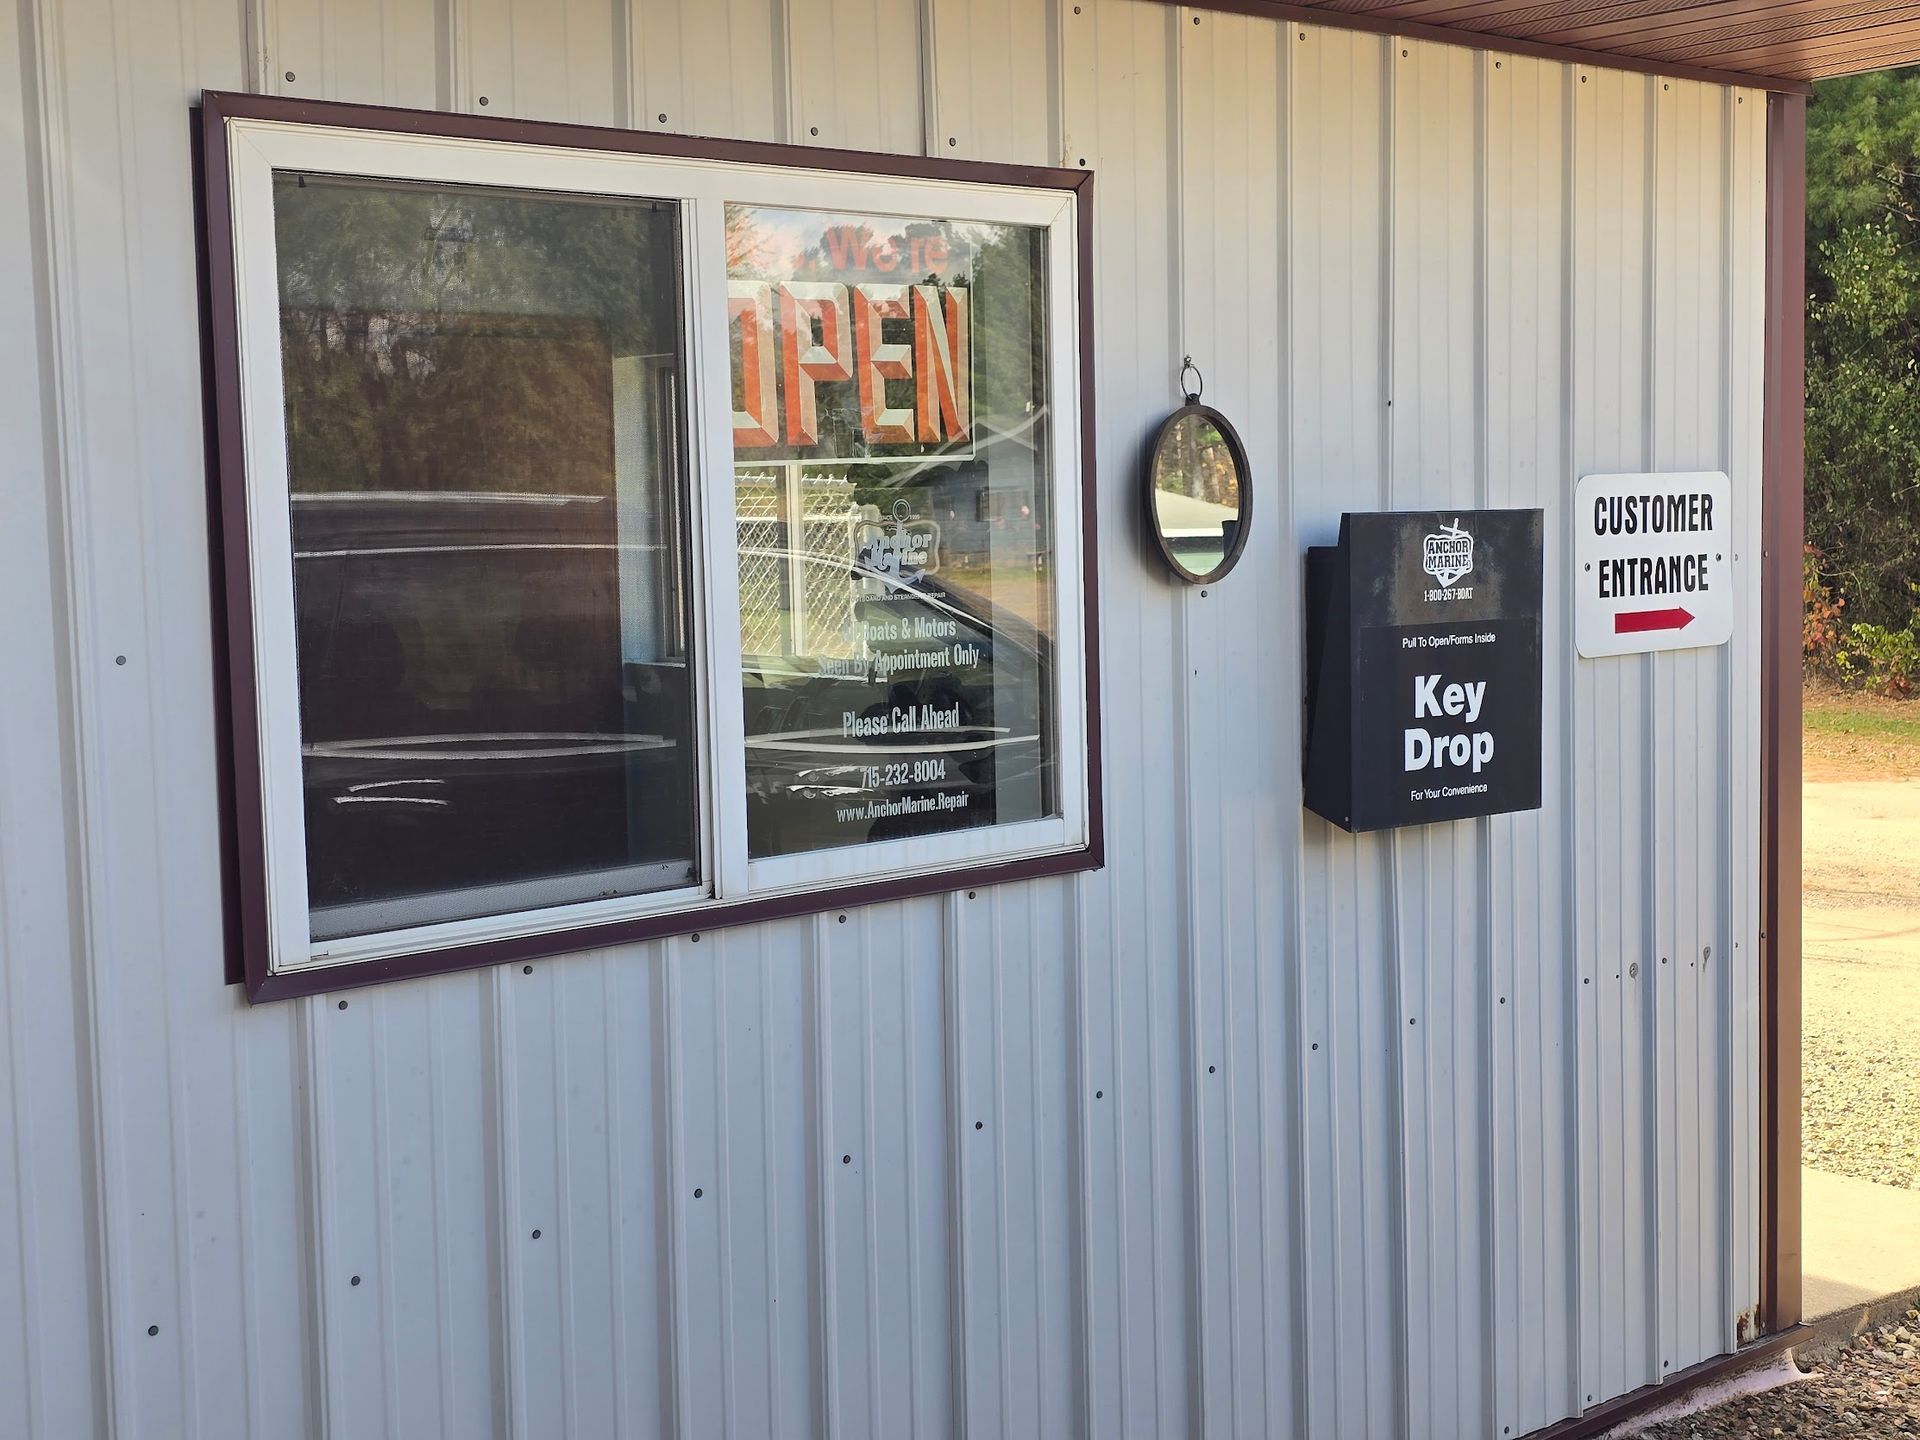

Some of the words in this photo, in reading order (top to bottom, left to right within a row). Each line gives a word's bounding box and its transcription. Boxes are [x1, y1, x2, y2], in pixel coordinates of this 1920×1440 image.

[825, 223, 949, 274] Were
[727, 280, 970, 447] OPEN
[1594, 493, 1713, 536] CUSTOMER
[1428, 541, 1469, 554] ANCHOR
[1428, 555, 1468, 569] MARINE
[1599, 553, 1709, 598] ENTRANCE
[863, 620, 898, 641] Boats
[901, 617, 911, 638] &
[914, 617, 957, 638] Motors
[1402, 637, 1417, 649] Pull
[1418, 636, 1427, 647] To
[1428, 633, 1473, 649] Open/Forms
[1474, 631, 1496, 644] Inside
[818, 655, 849, 675] Seen
[854, 653, 870, 678] By
[875, 648, 950, 675] Appointment
[953, 643, 979, 668] Only
[1415, 674, 1487, 723] Key
[843, 711, 888, 738] Please
[891, 705, 916, 733] Call
[921, 702, 960, 730] Ahead
[1404, 727, 1494, 773] Drop
[860, 759, 946, 789] 715-232-8004
[837, 791, 970, 823] www.AnchorMarine.Repair
[1411, 790, 1424, 801] For
[1424, 788, 1441, 800] Your
[1442, 783, 1488, 798] Convenience
